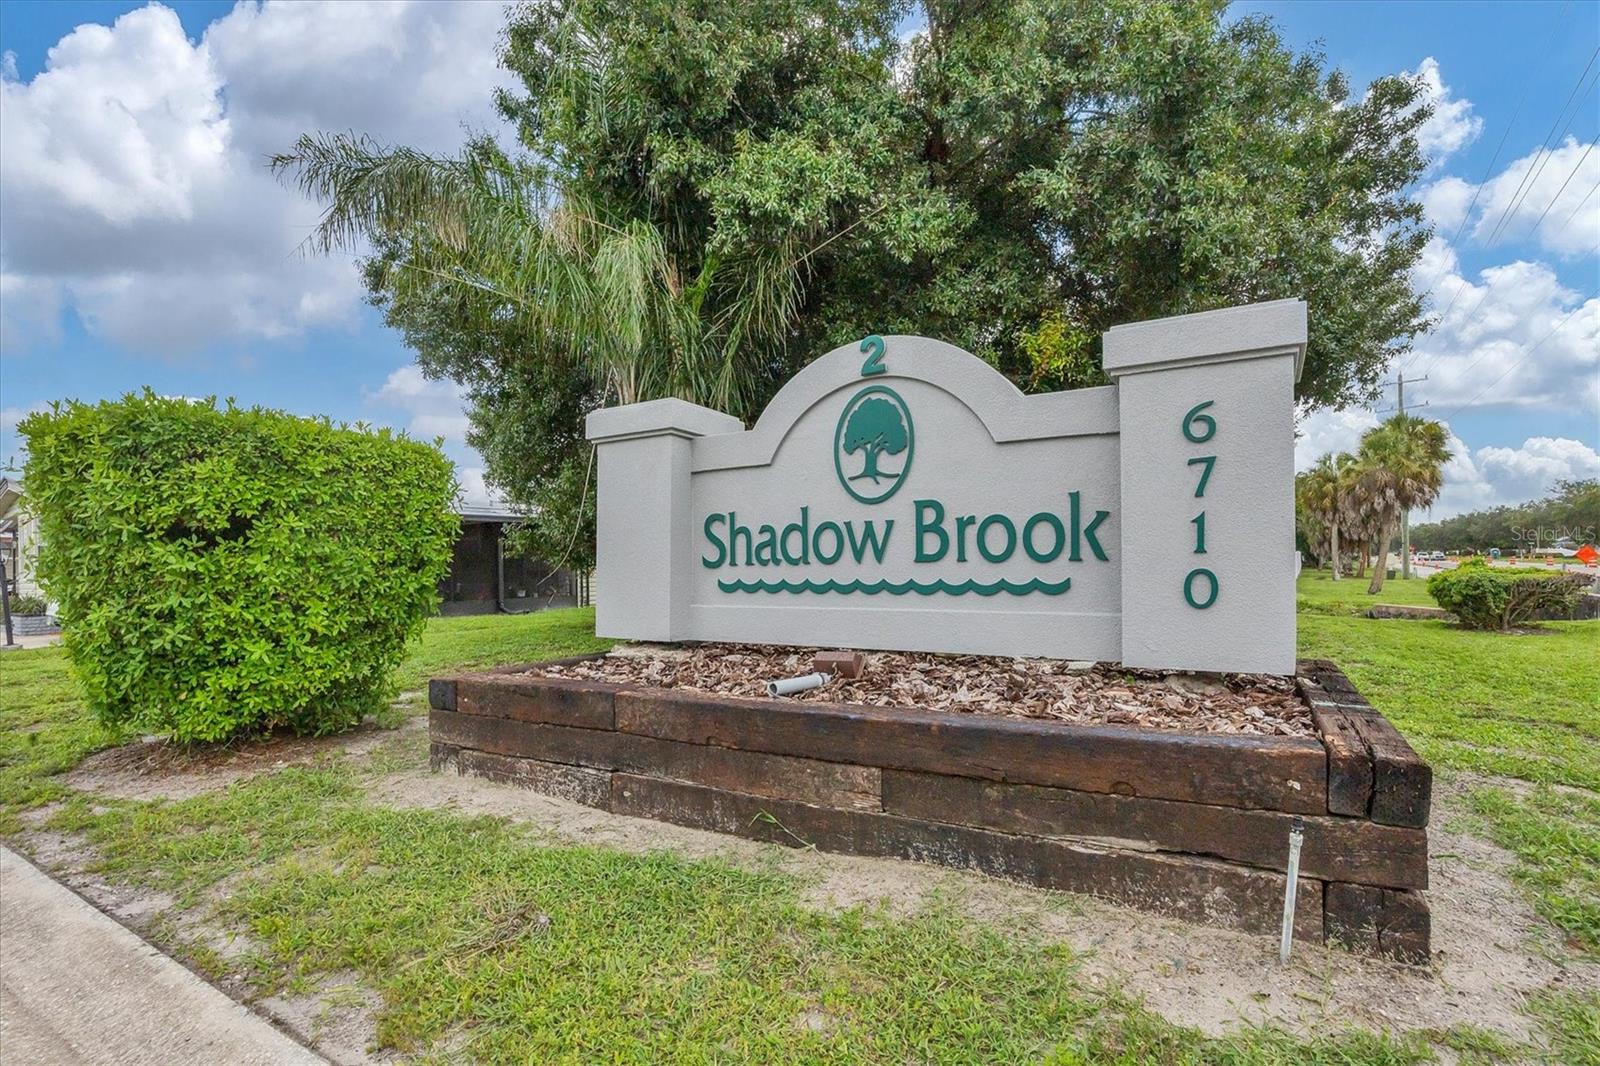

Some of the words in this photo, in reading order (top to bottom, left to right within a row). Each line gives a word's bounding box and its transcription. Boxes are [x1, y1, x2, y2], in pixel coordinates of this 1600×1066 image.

[860, 335, 886, 376] 2
[702, 506, 895, 569] Shadow
[914, 491, 1109, 563] Brook
